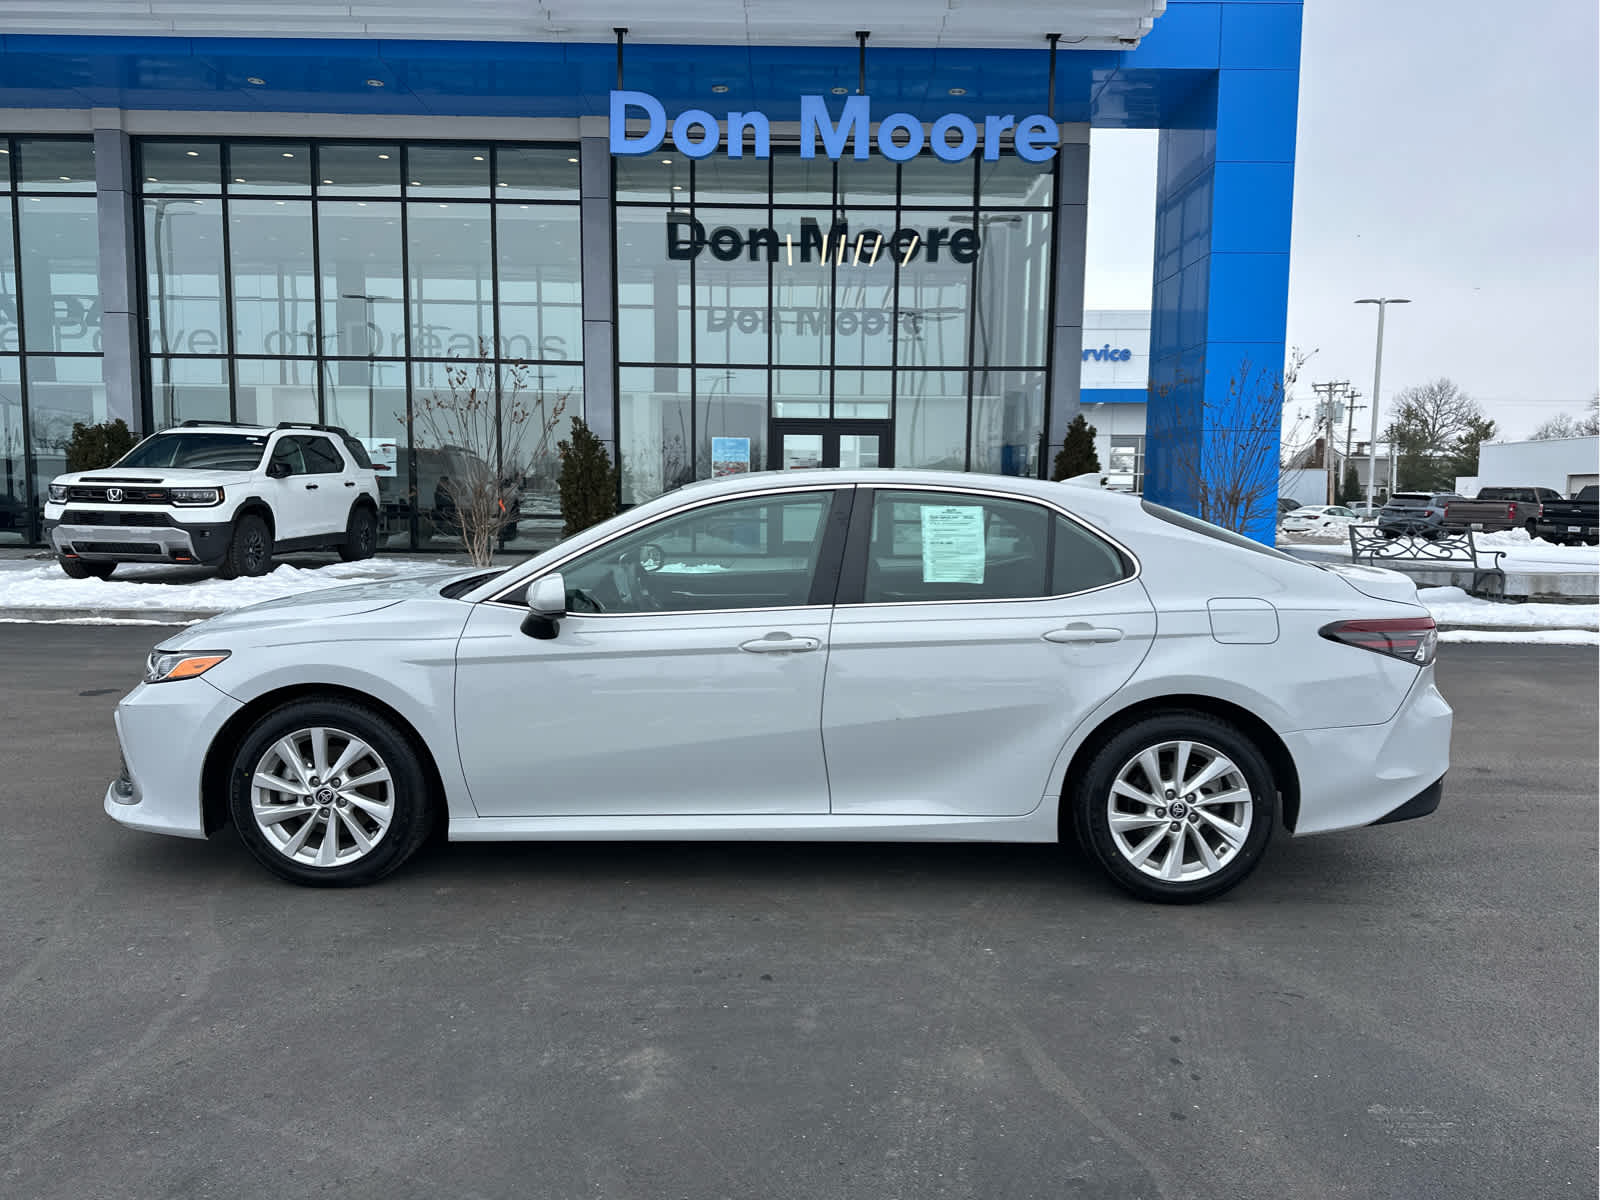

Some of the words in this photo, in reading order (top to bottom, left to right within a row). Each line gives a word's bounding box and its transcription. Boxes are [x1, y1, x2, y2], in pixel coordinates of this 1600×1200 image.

[610, 89, 769, 160] Don
[800, 95, 1060, 163] Moore
[666, 212, 779, 261] Don
[800, 217, 980, 264] Moore
[706, 307, 782, 335] Don
[1081, 344, 1132, 362] rvice
